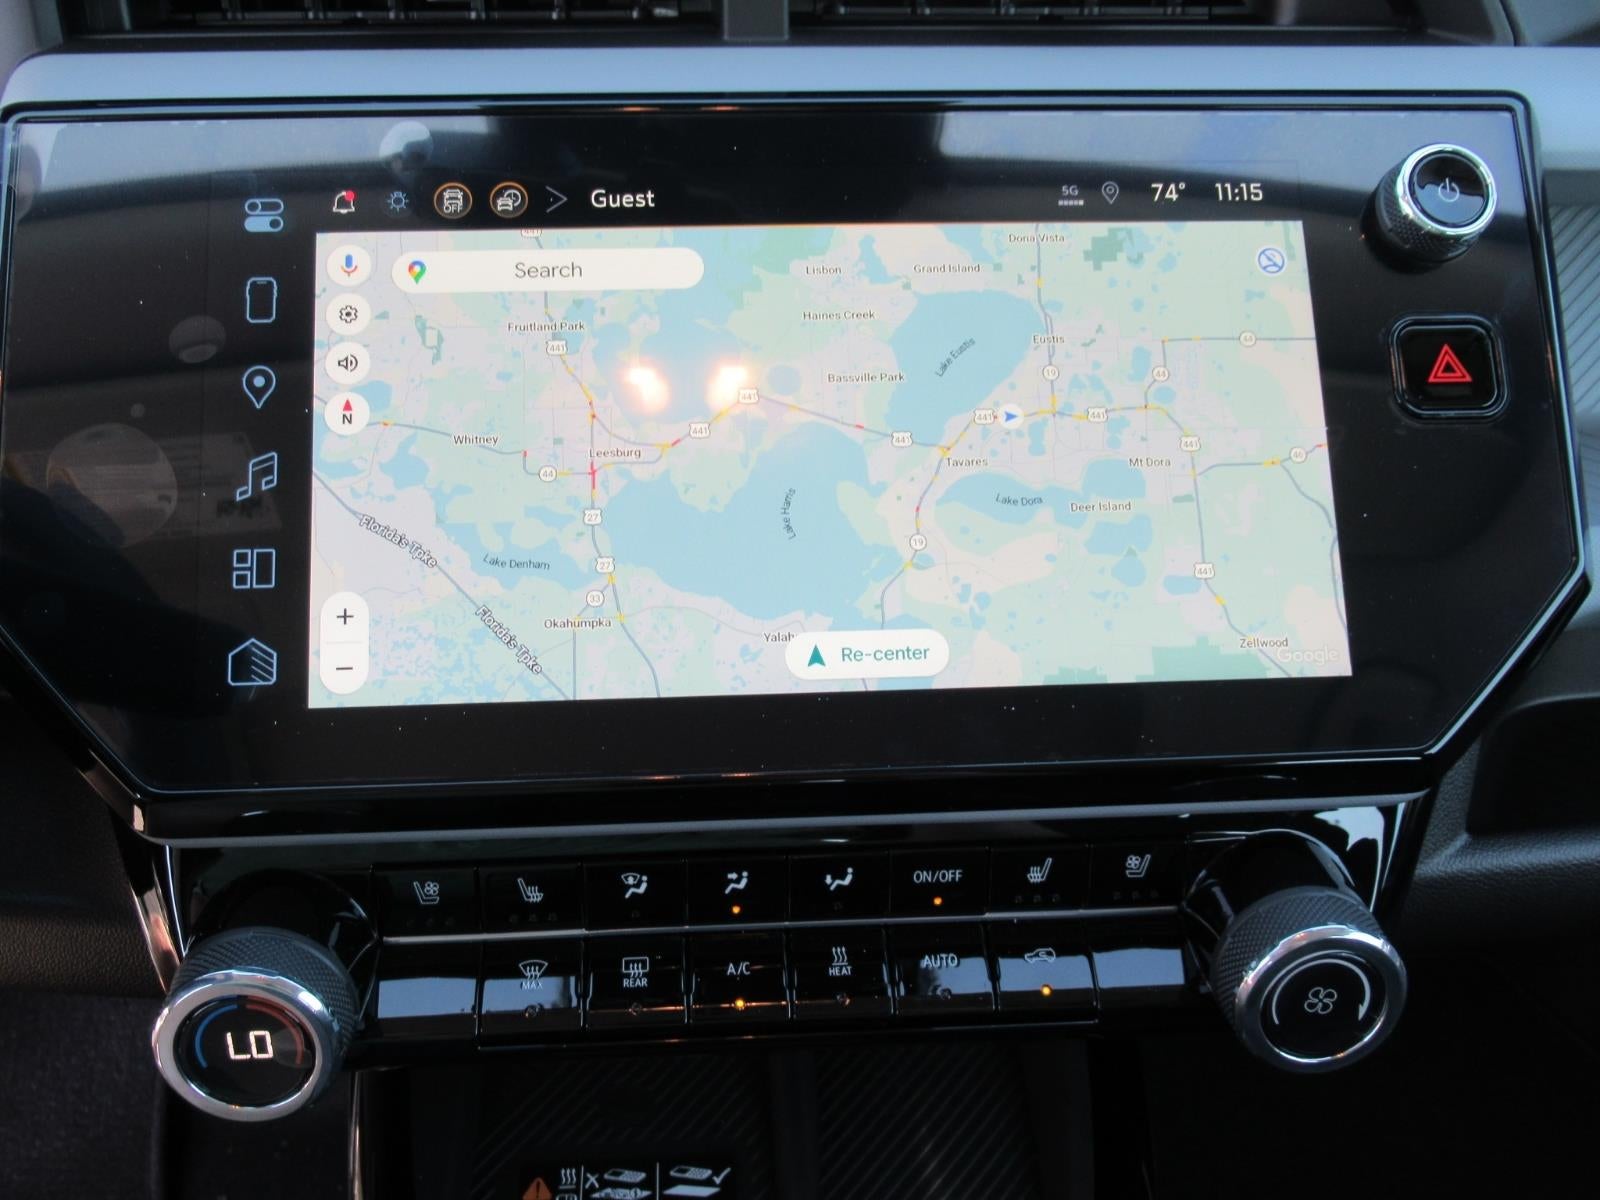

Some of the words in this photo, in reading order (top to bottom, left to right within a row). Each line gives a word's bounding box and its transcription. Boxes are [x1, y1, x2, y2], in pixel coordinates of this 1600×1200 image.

[1061, 185, 1079, 196] 5G
[1151, 182, 1186, 202] 74°
[1215, 183, 1263, 202] 11:15
[590, 189, 655, 208] Guest
[1009, 234, 1035, 243] Dona
[1038, 234, 1065, 242] Vista
[514, 261, 583, 280] Search
[805, 265, 842, 275] Lisbon
[913, 264, 946, 274] Grand
[949, 263, 980, 273] Island
[802, 311, 841, 320] Haines
[843, 310, 875, 320] Creek
[507, 322, 555, 332] Fruitland
[559, 321, 585, 331] Park
[1033, 334, 1065, 344] Eustis
[549, 343, 566, 353] 441
[935, 358, 953, 377] Lake
[950, 338, 976, 360] Eustis
[827, 373, 877, 383] Bassville
[879, 372, 905, 382] Park
[1045, 368, 1057, 377] 19
[1155, 370, 1166, 378] 44
[741, 391, 757, 401] 441
[342, 413, 352, 424] N
[976, 413, 992, 421] 441
[1089, 411, 1105, 420] 441
[692, 426, 708, 436] 441
[453, 434, 499, 446] Whitney
[893, 435, 909, 444] 441
[1183, 440, 1199, 449] 441
[589, 448, 641, 460] Leesburg
[946, 457, 988, 467] Tavares
[1128, 458, 1143, 467] Mt
[1146, 457, 1171, 467] Dora
[542, 469, 554, 479] 44
[995, 494, 1022, 507] Lake
[1024, 496, 1043, 506] Dora
[1070, 502, 1097, 512] Deer
[1100, 501, 1132, 511] Island
[586, 512, 600, 523] 27
[782, 515, 796, 539] Lake
[359, 516, 408, 549] Florida's
[407, 542, 438, 569] Tpke
[911, 537, 925, 547] 19
[483, 553, 506, 570] Lake
[509, 557, 550, 570] Denham
[599, 560, 612, 571] 27
[1195, 566, 1213, 576] 441
[588, 593, 602, 603] 33
[544, 617, 612, 631] Okahumpka
[475, 606, 518, 650] Florida's
[515, 646, 543, 675] Tpke
[1239, 636, 1289, 649] Zellwood
[841, 644, 930, 663] Re-center
[1276, 648, 1339, 668] Google
[913, 868, 963, 884] ON/OFF
[922, 953, 959, 970] AUTO
[727, 961, 751, 976] A/C
[829, 965, 852, 977] HEAT
[521, 980, 543, 991] MAX
[623, 978, 648, 988] REAR
